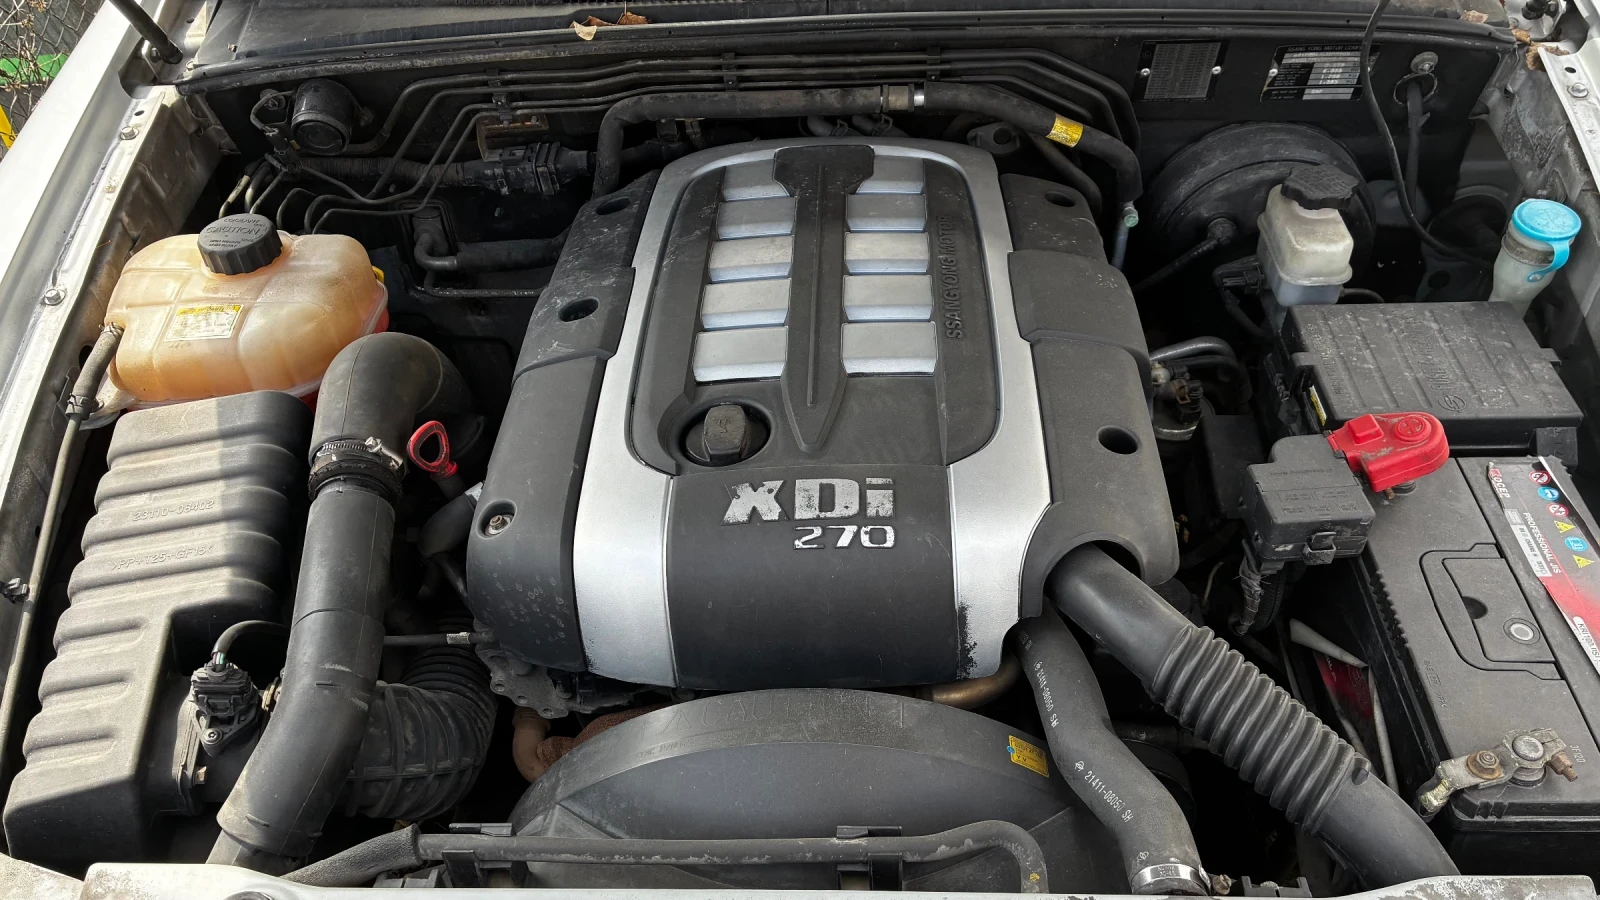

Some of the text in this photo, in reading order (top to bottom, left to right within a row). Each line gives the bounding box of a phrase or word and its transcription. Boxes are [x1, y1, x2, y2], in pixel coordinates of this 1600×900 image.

[206, 226, 260, 235] CAUTION
[939, 215, 963, 339] SSANGYONG MOTOR
[720, 477, 894, 526] XDi
[794, 525, 895, 549] 270
[1523, 512, 1554, 562] PROFESSIONAL
[1550, 559, 1562, 574] JIS
[1084, 770, 1134, 823] 21411-08050 SH
